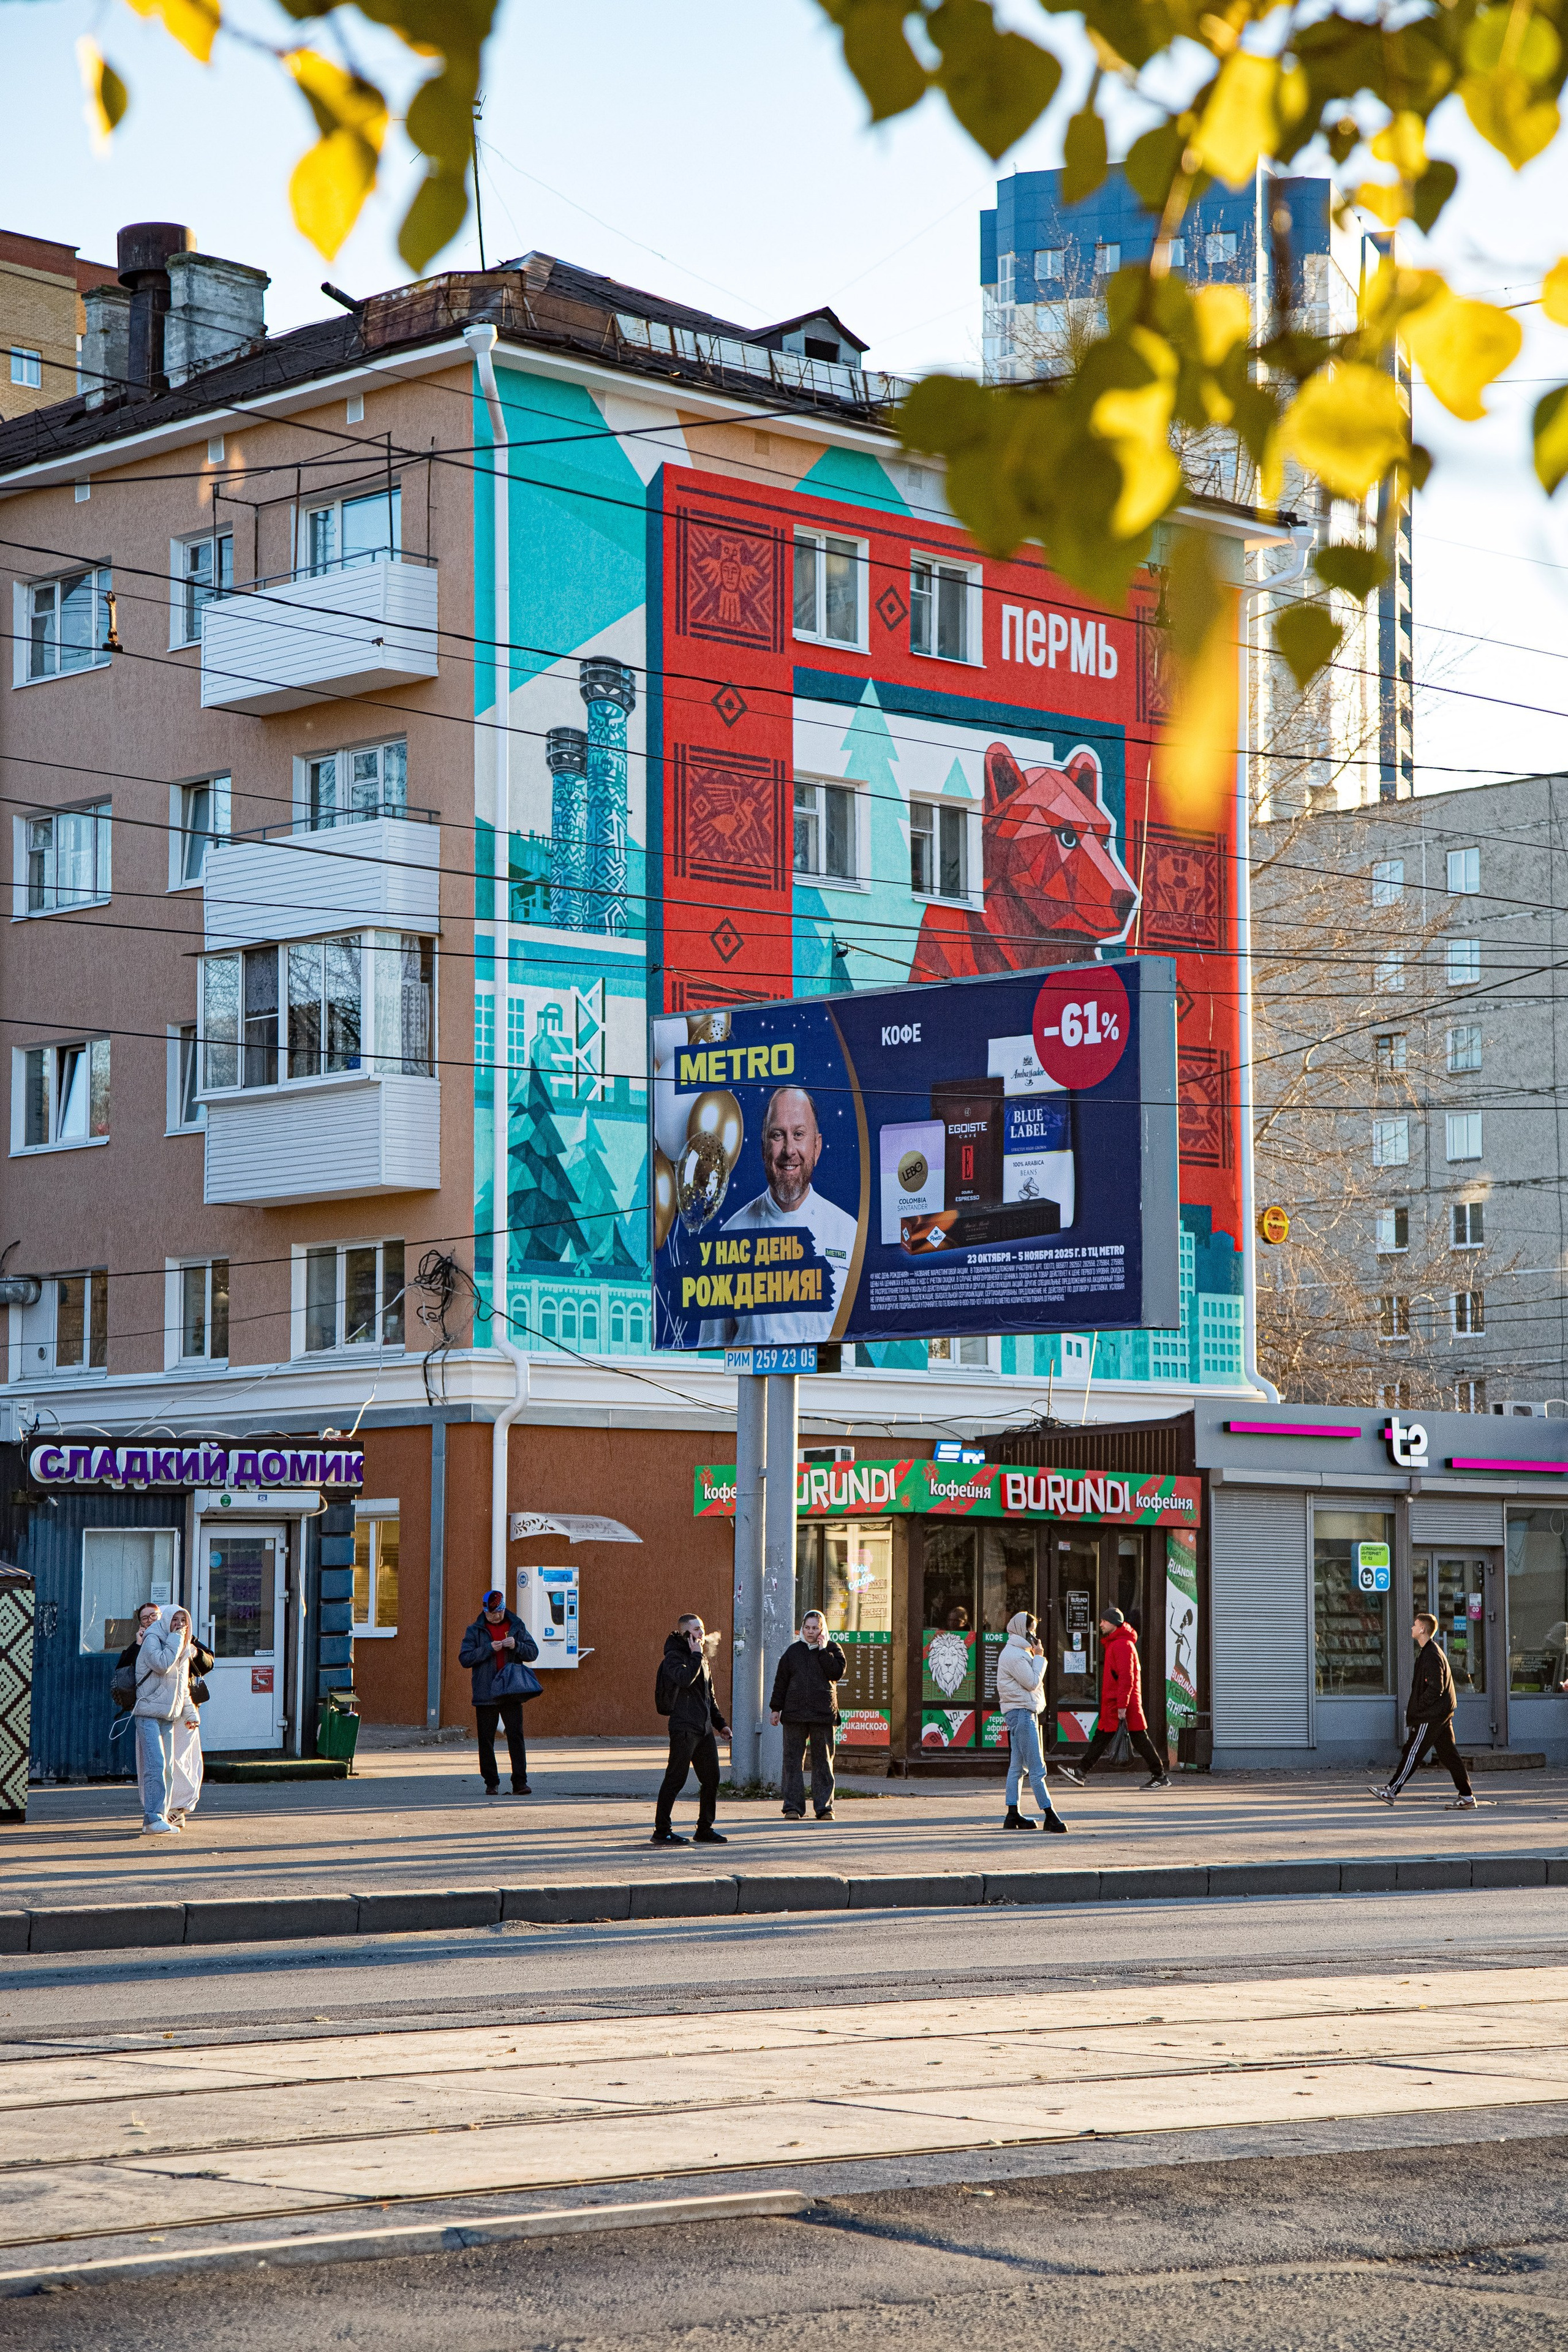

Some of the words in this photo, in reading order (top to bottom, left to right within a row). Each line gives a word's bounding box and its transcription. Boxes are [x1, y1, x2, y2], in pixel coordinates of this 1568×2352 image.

[881, 1023, 921, 1046] КОФЕ
[680, 1043, 794, 1085] METRO
[1014, 1109, 1043, 1123] BLUE
[949, 1122, 987, 1134] EGOISTE
[1011, 1123, 1047, 1139] LABEL
[699, 1242, 712, 1265] У
[715, 1238, 750, 1264] НАС
[754, 1235, 804, 1266] ДЕНЬ
[827, 1250, 845, 1258] METRO
[967, 1254, 976, 1264] 23
[978, 1252, 1011, 1263] ОКТЯБРЯ
[1018, 1251, 1023, 1261] 5
[1024, 1250, 1053, 1261] НОЯБРЯ
[1054, 1248, 1073, 1259] 2025
[1074, 1248, 1080, 1257] Г.
[1081, 1247, 1087, 1257] В
[1087, 1246, 1098, 1257] ТЦ
[1099, 1245, 1125, 1256] METRO
[682, 1268, 822, 1310] РОЖДЕНИЯ!
[728, 1352, 750, 1367] РИМ
[756, 1349, 777, 1368] 259
[782, 1349, 796, 1368] 23
[801, 1348, 815, 1367] 05
[1385, 1417, 1428, 1467] t2
[39, 1443, 229, 1484] СЛАДКИЙ
[233, 1450, 365, 1486] ДОМИК
[704, 1482, 736, 1503] кофе
[797, 1468, 897, 1509] URUNDI
[930, 1478, 991, 1501] кофейня
[1003, 1472, 1131, 1515] BURUNDI
[1136, 1493, 1193, 1512] кофейня
[1167, 1558, 1194, 1578] RUANDA
[1362, 1572, 1372, 1585] t2
[840, 1722, 888, 1732] риканского
[930, 1711, 960, 1743] BURUNDI
[987, 1724, 1009, 1733] африк
[835, 1731, 847, 1744] фе
[985, 1733, 1002, 1743] кофе
